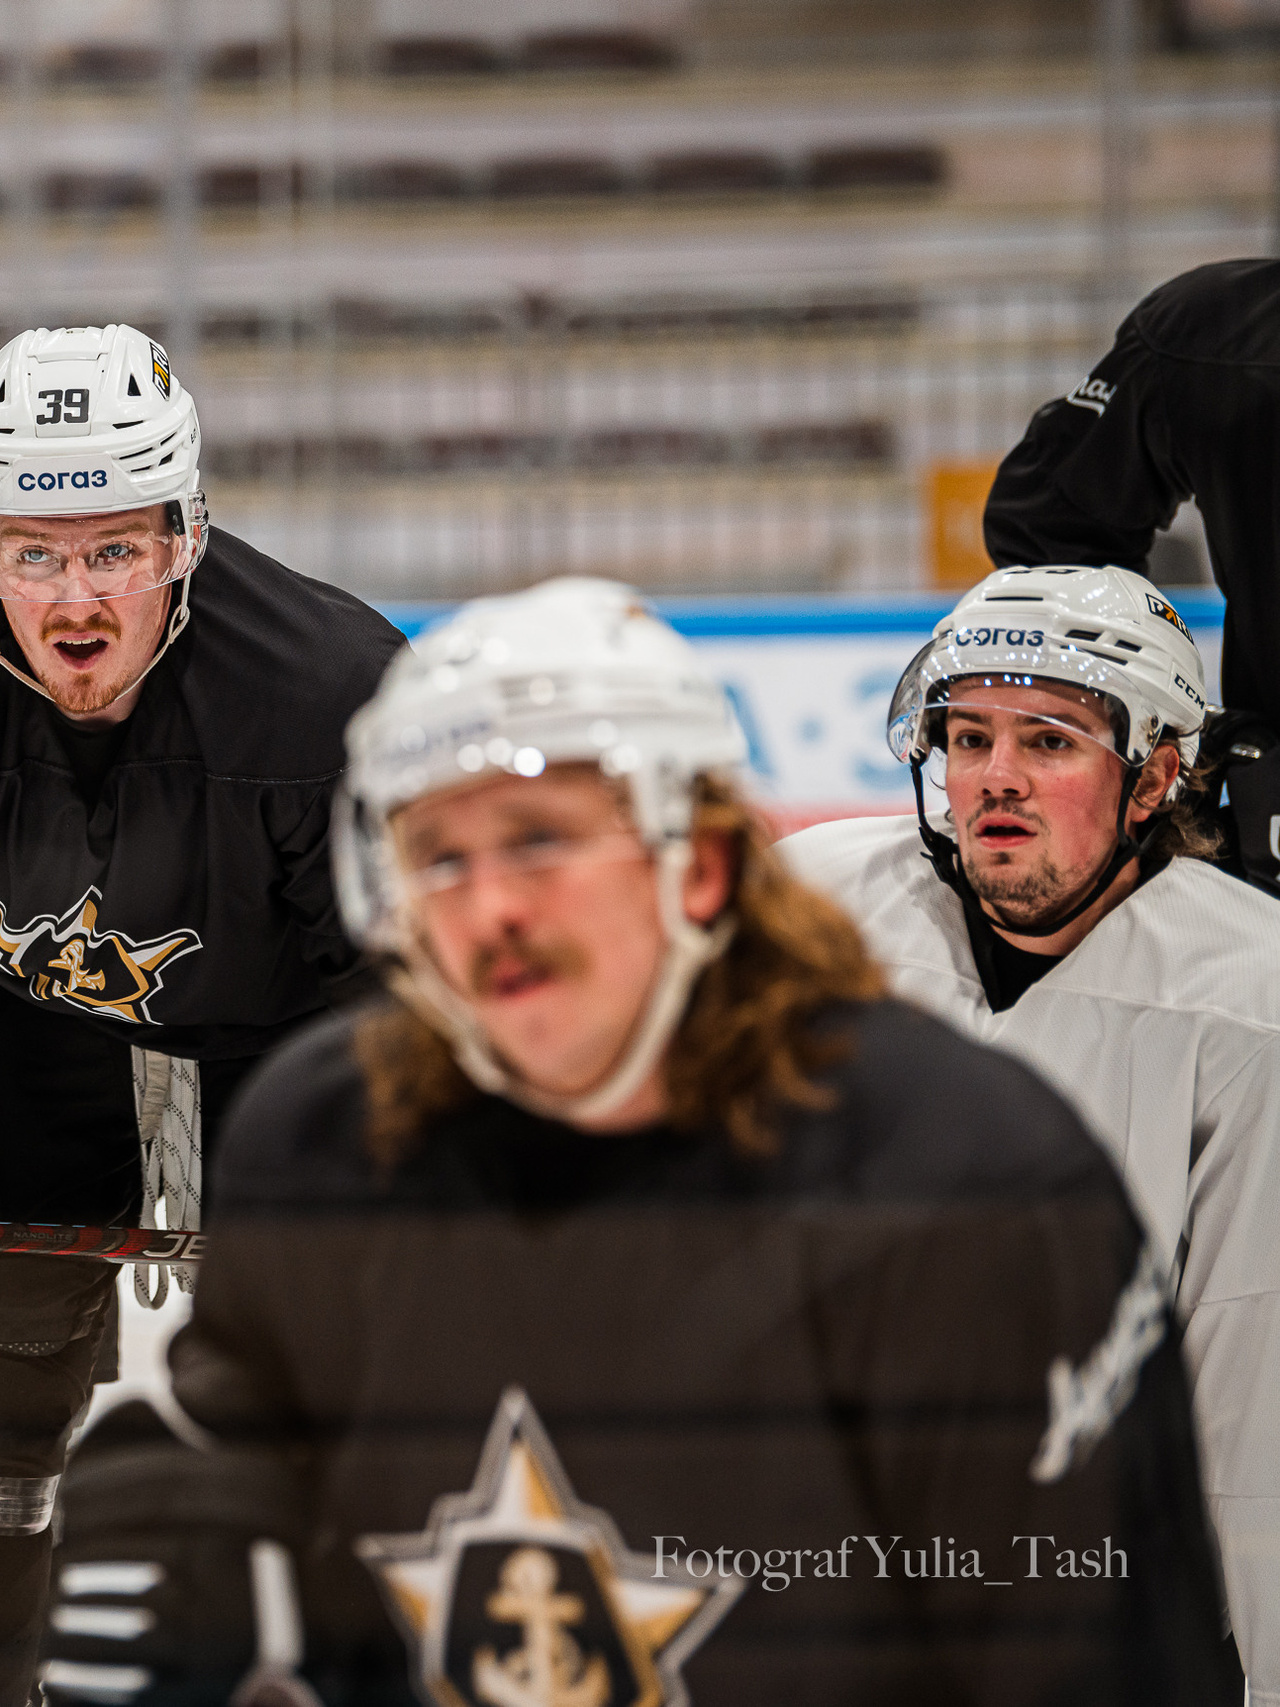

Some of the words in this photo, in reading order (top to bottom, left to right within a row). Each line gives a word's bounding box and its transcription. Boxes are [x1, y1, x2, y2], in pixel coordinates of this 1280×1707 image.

[36, 388, 90, 426] 39
[18, 469, 108, 491] согаз
[1174, 673, 1206, 711] CCM
[142, 1233, 210, 1260] JE
